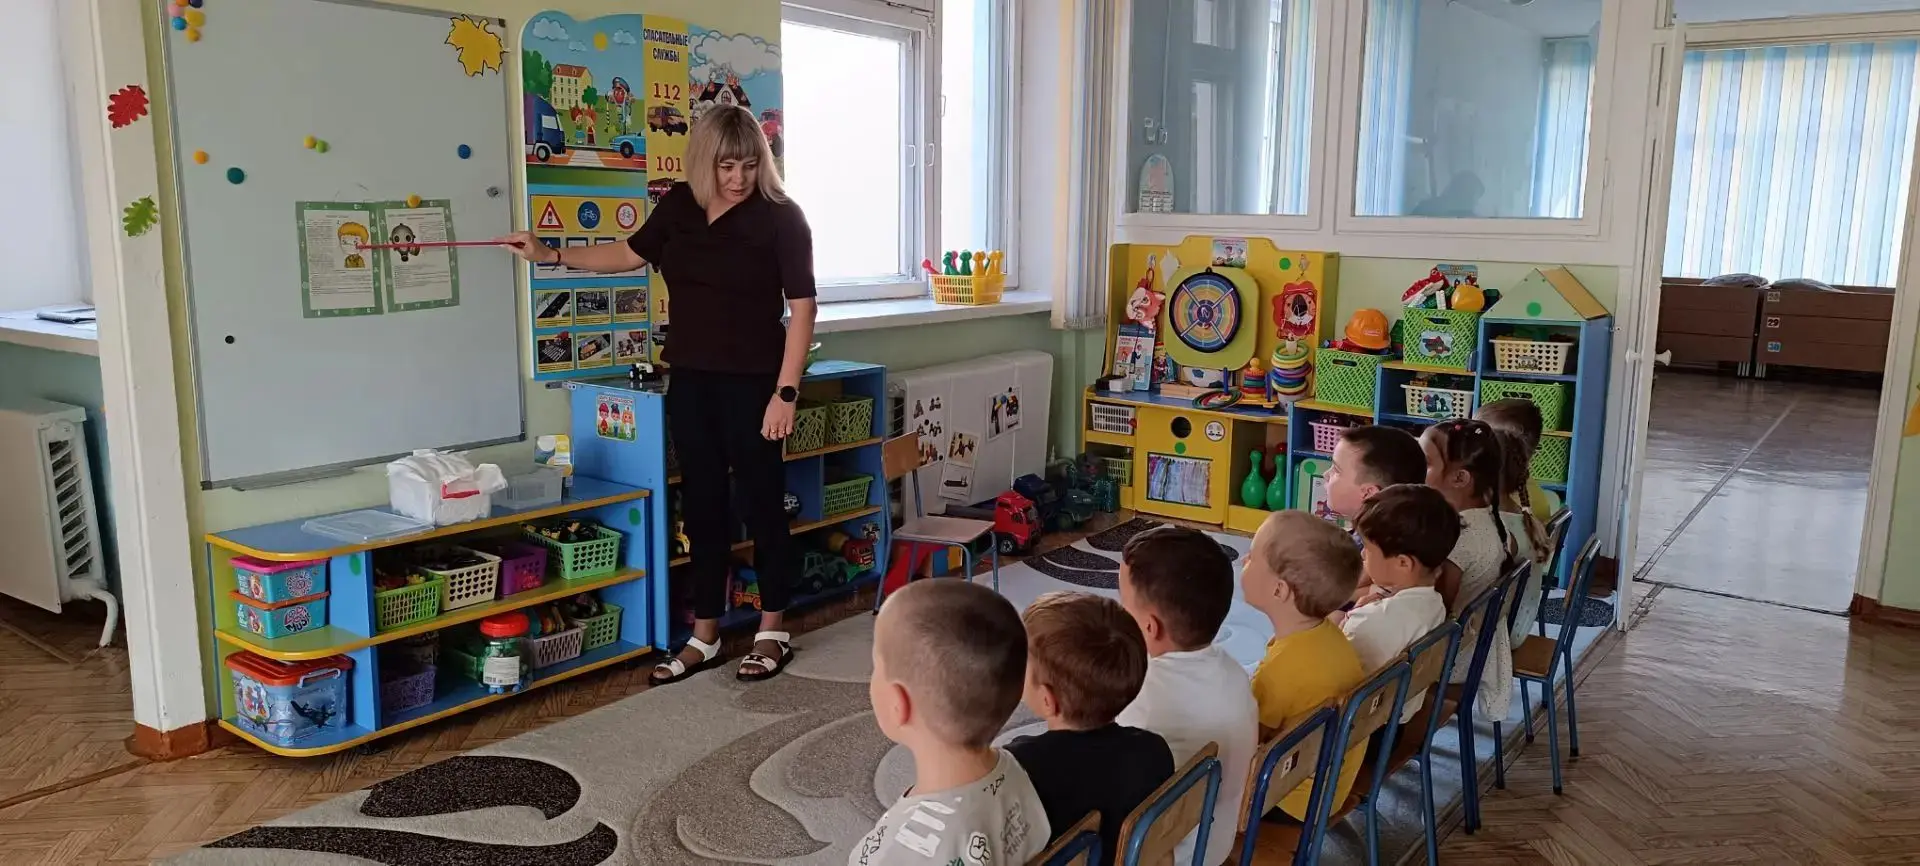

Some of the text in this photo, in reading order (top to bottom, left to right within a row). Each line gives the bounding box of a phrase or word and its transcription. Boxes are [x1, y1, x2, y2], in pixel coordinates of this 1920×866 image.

[643, 28, 689, 46] СПАСАТЕЛЬНЫЕ
[653, 48, 680, 62] СЛУЖБЫ
[653, 83, 681, 100] 112
[656, 156, 682, 172] 101
